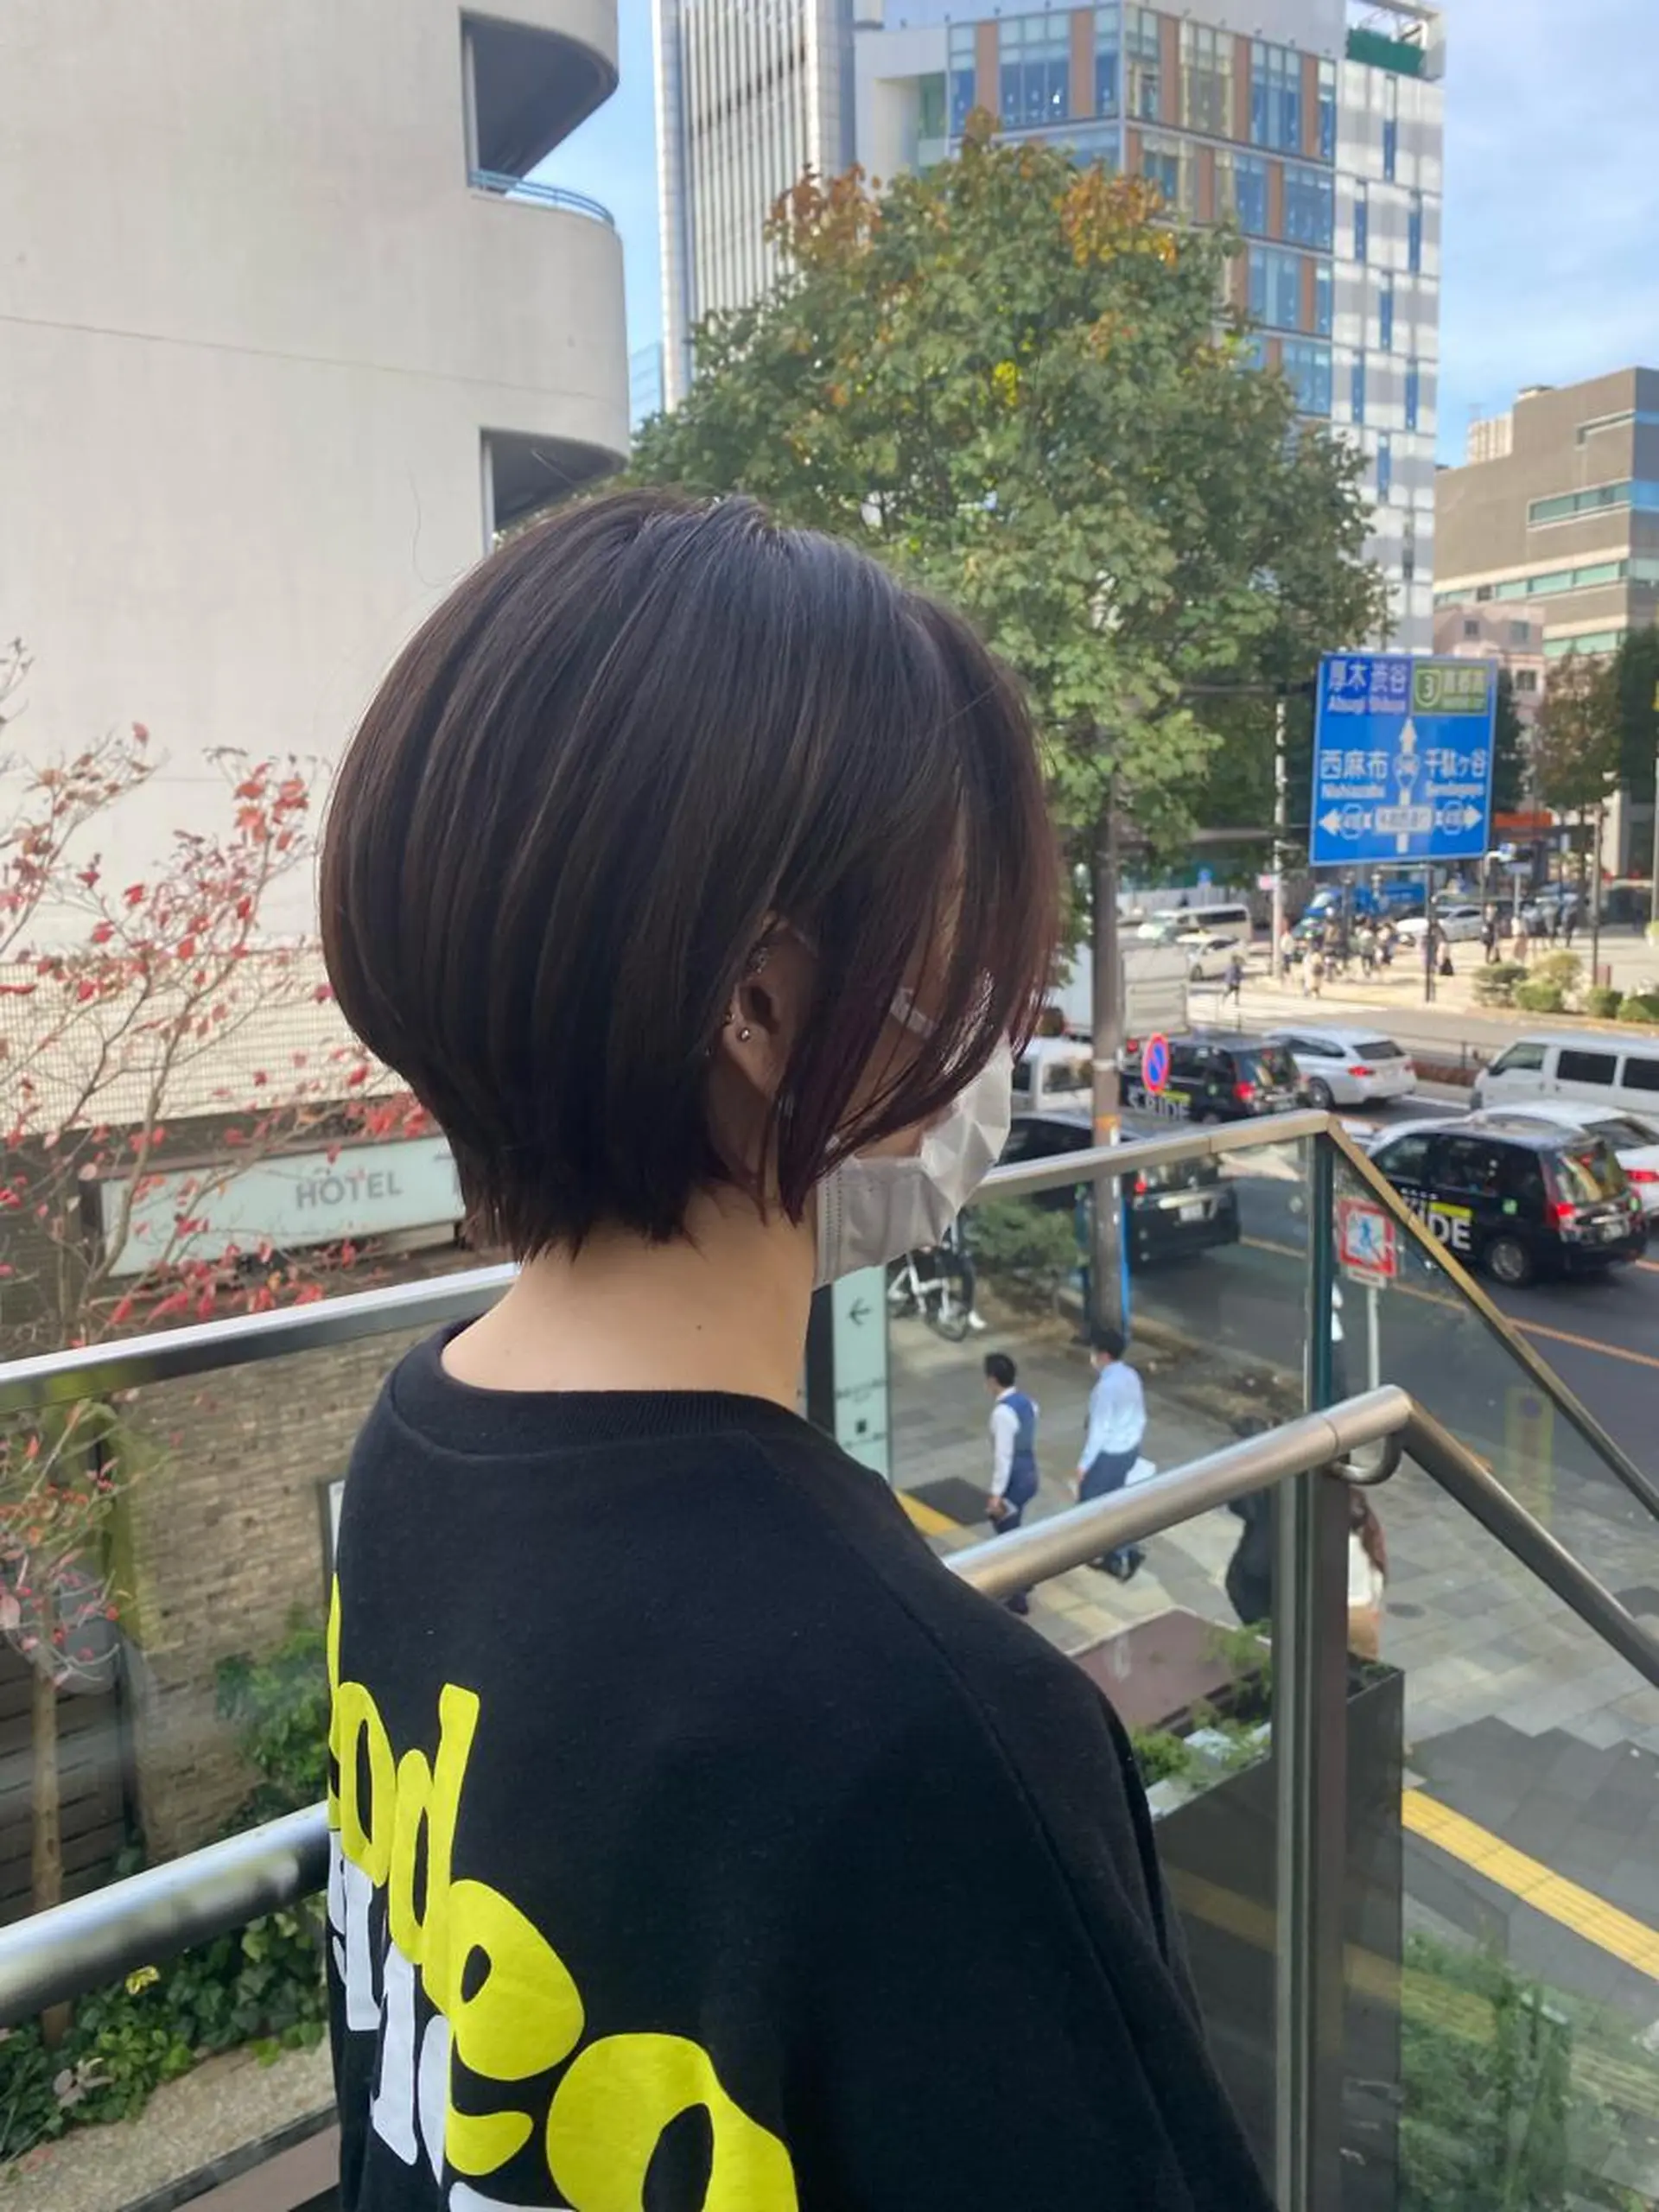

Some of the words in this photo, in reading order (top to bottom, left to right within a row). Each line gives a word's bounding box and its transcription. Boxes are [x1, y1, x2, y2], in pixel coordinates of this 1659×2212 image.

[1424, 675, 1434, 698] 3
[1320, 749, 1390, 779] 西麻布
[296, 1172, 404, 1209] HOTEL
[327, 1576, 799, 2212] odeo
